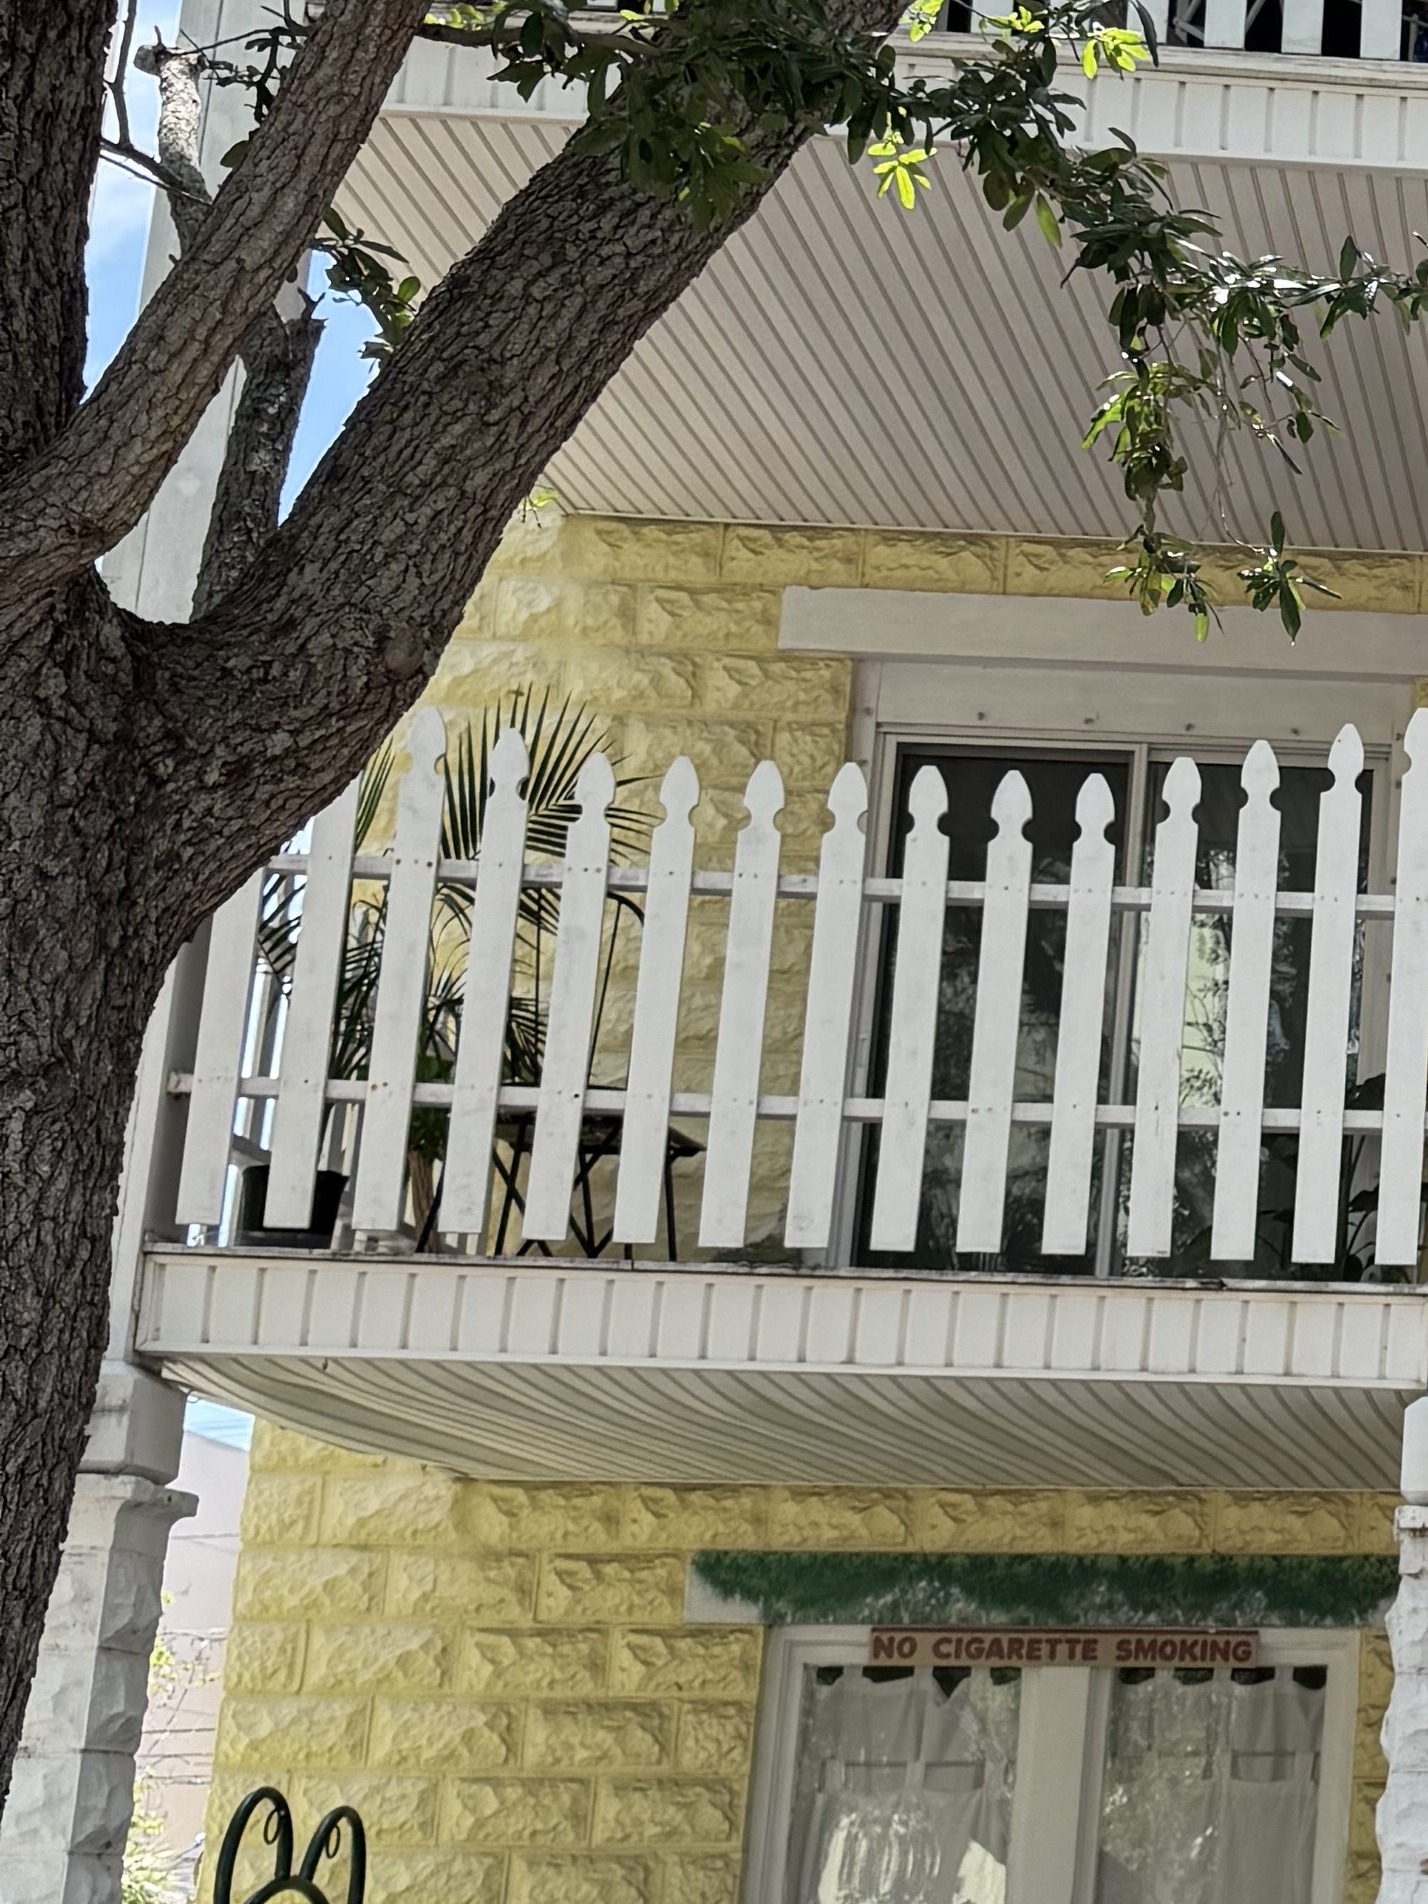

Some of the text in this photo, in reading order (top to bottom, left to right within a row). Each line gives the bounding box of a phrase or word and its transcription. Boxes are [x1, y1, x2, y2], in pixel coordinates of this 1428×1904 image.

[872, 1635, 1252, 1663] NO CIGARETTE SMOKING
